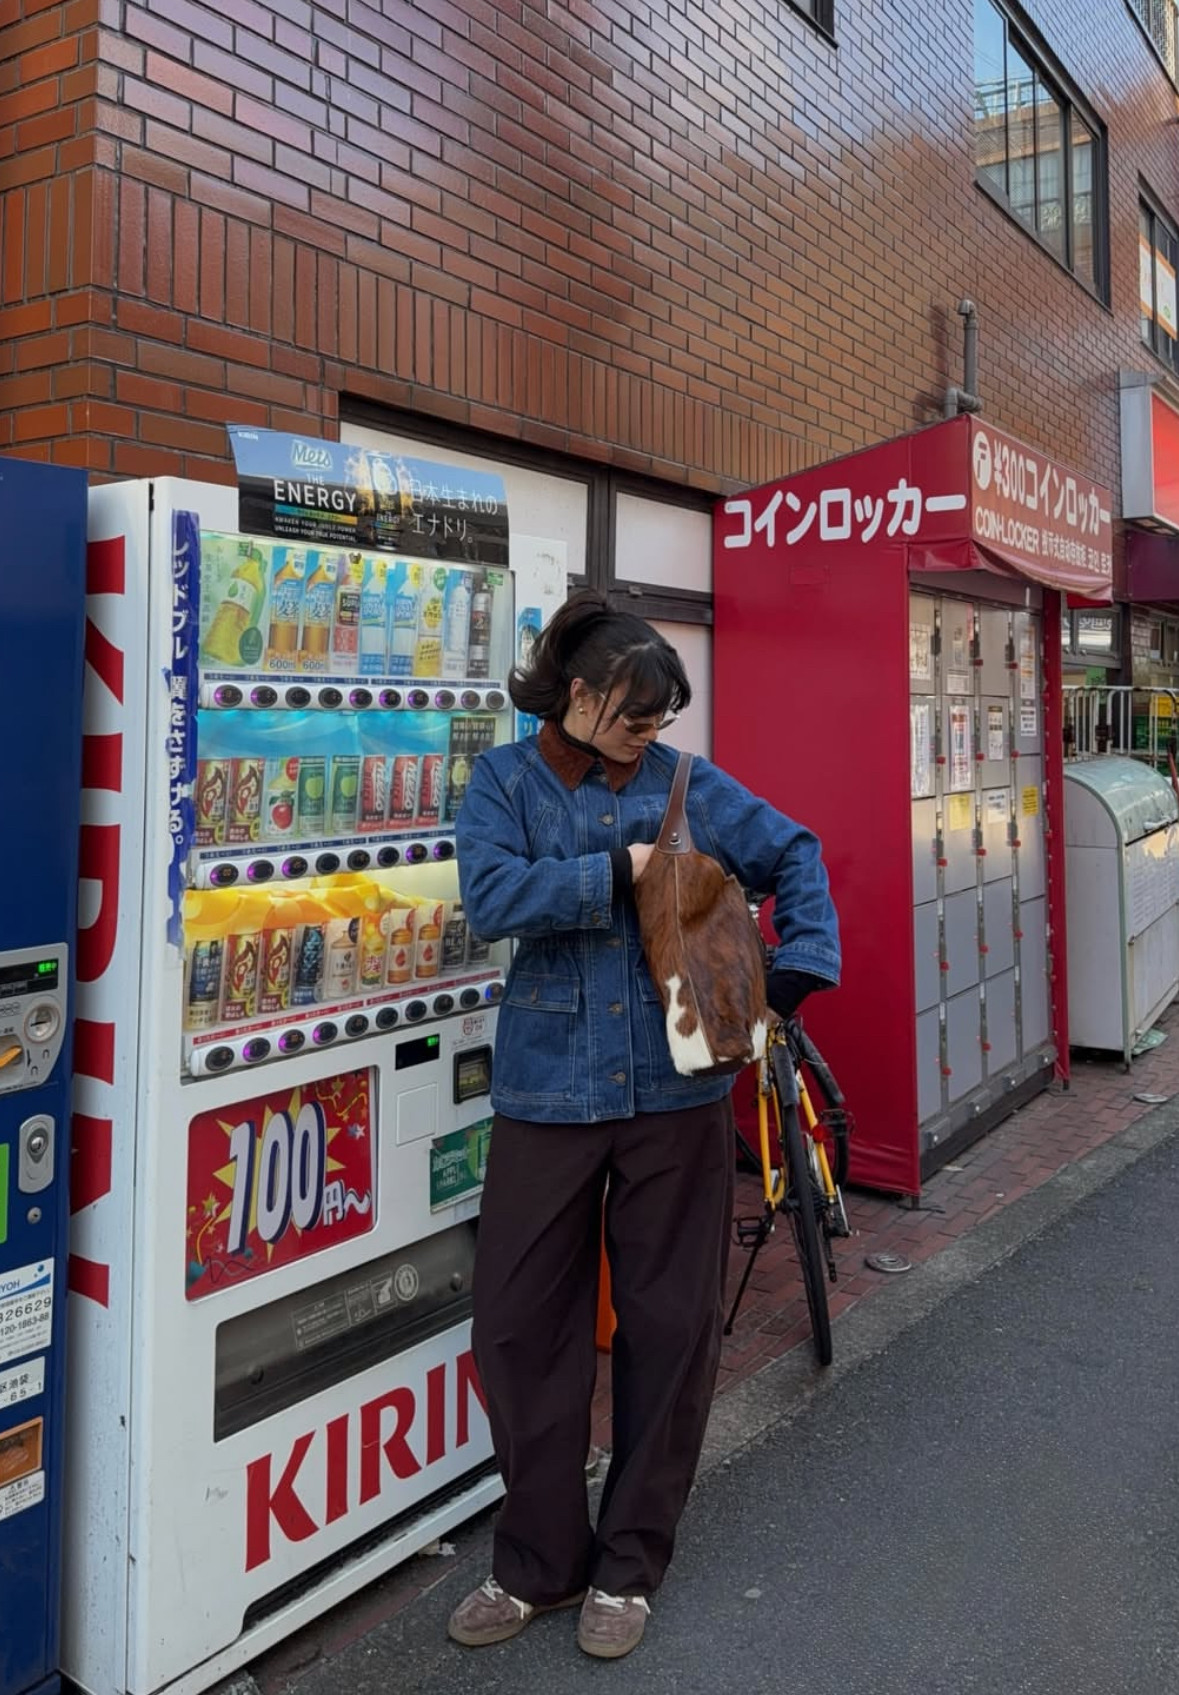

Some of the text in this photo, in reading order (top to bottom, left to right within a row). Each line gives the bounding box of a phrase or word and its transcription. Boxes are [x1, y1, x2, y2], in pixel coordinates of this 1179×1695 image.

[292, 441, 332, 468] Mets
[273, 479, 357, 513] ENERGY
[409, 478, 499, 516] 日本生まれの
[724, 478, 967, 548] コインロッカー
[411, 512, 474, 544] エナドリ。
